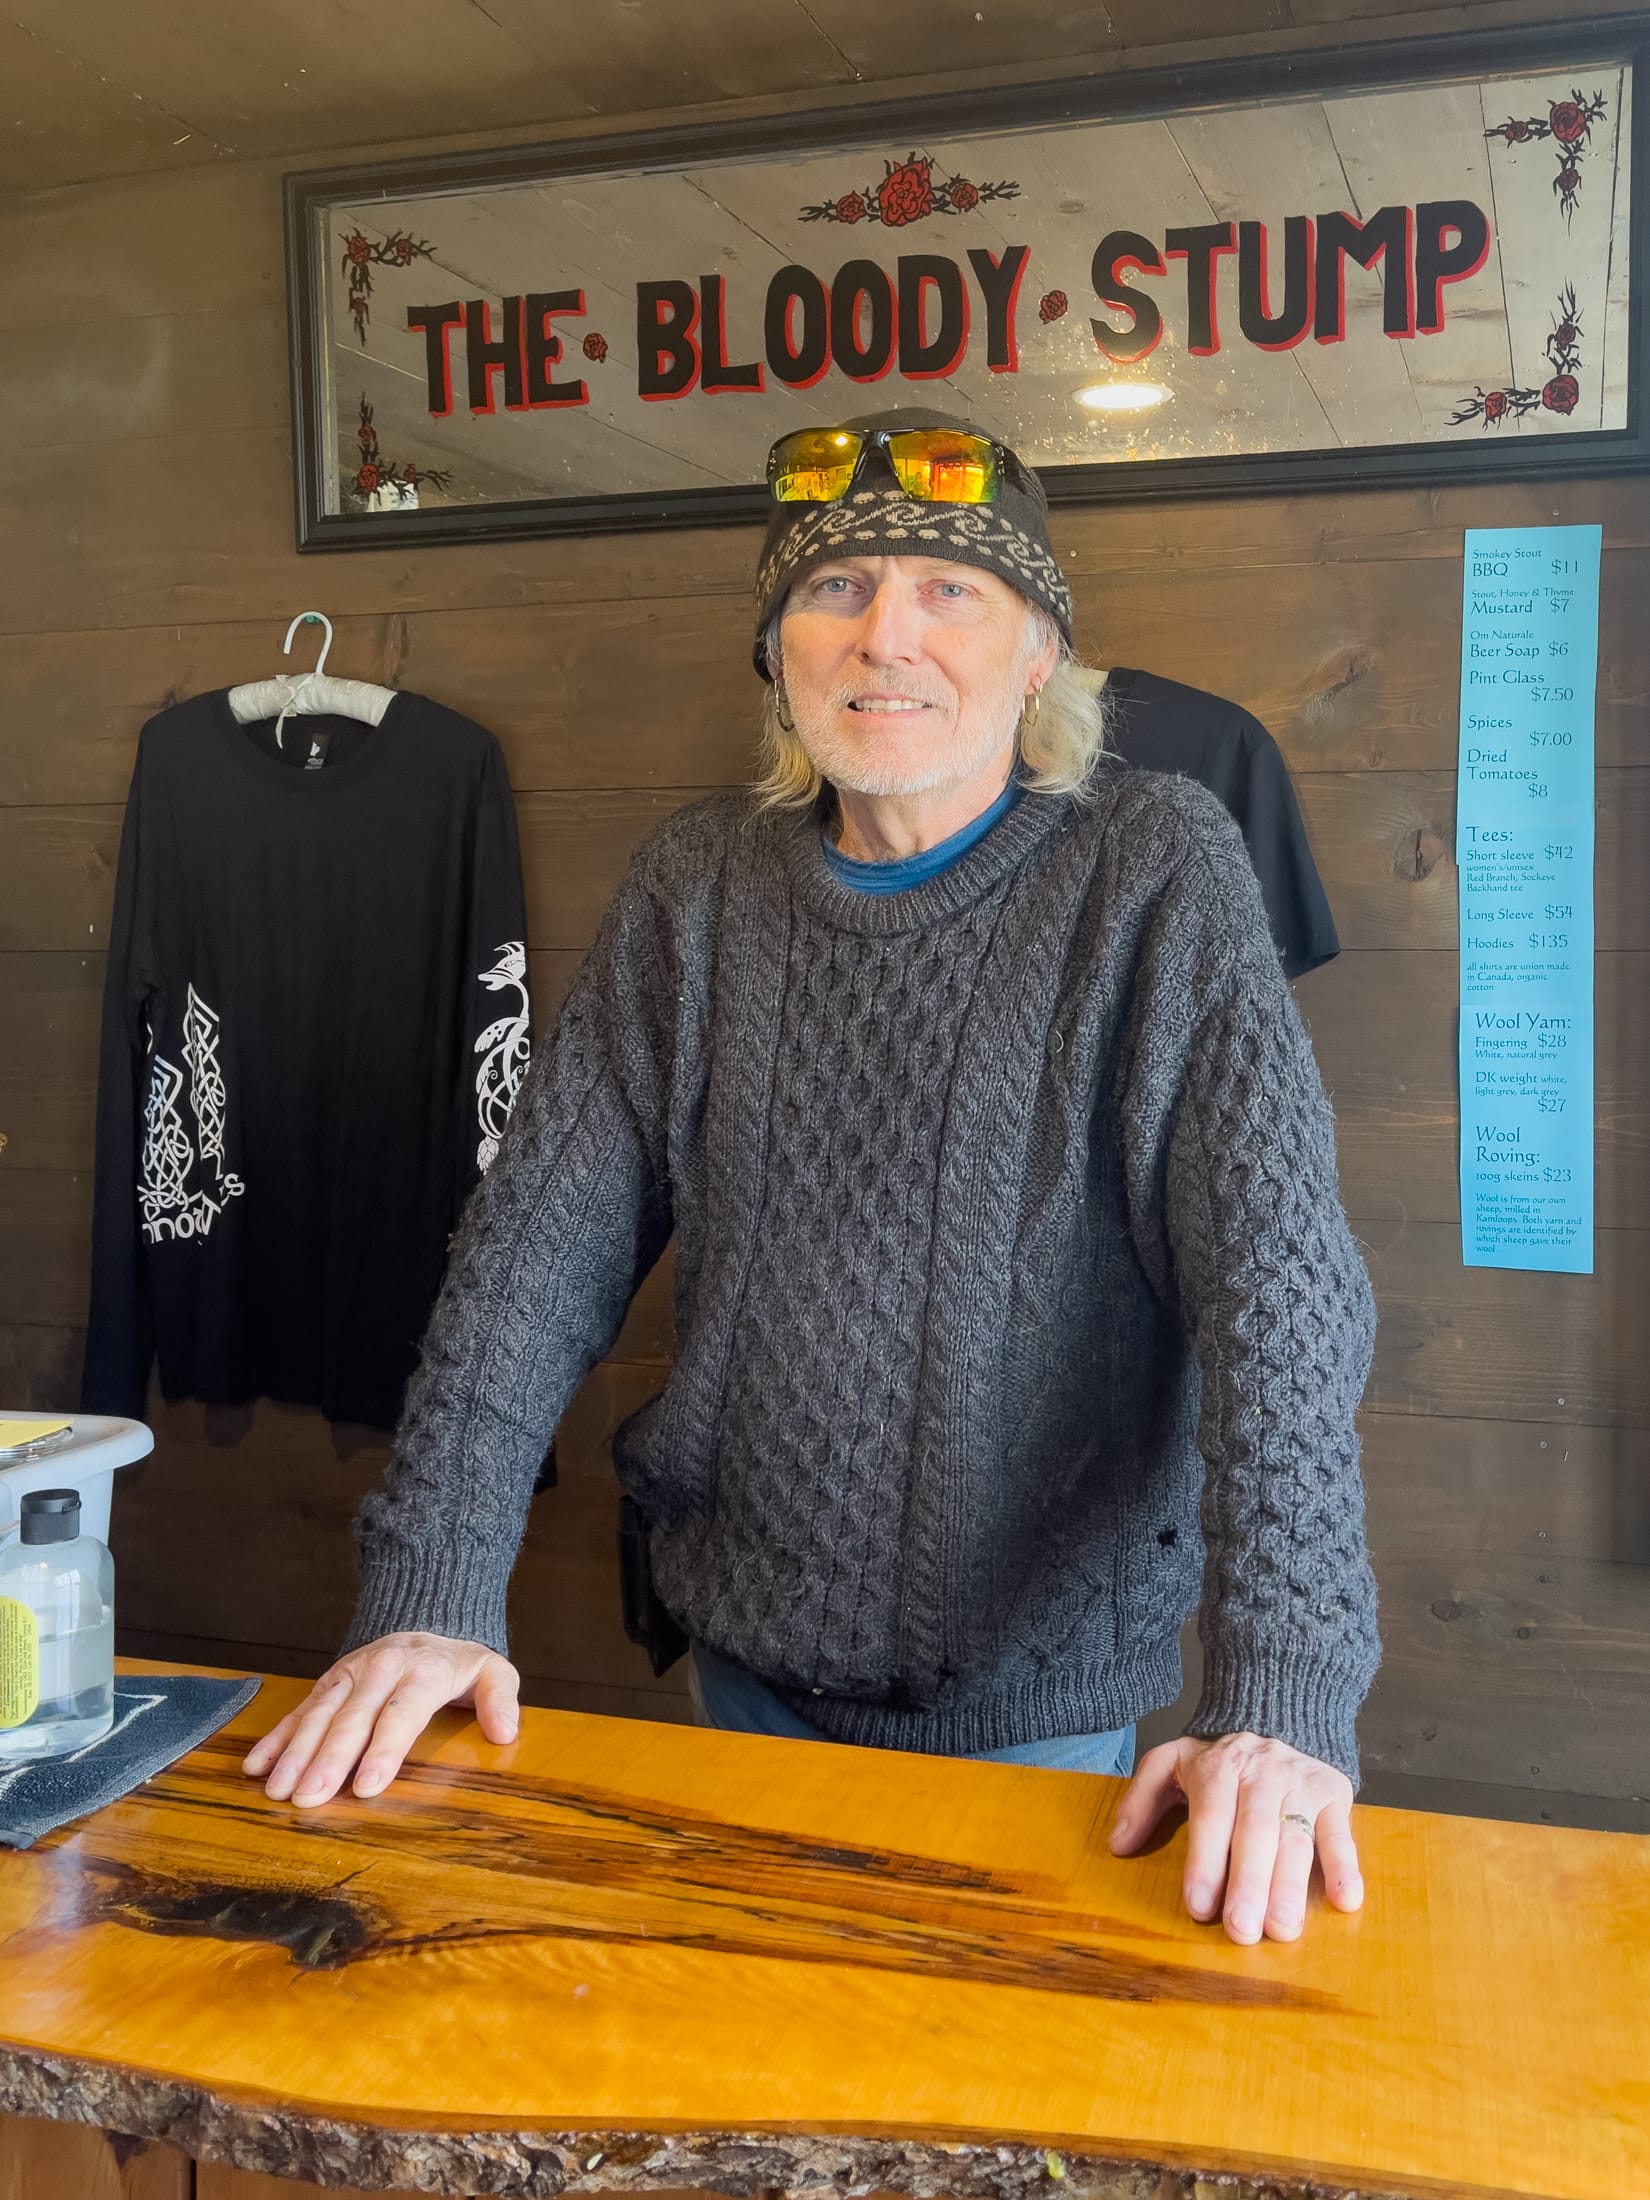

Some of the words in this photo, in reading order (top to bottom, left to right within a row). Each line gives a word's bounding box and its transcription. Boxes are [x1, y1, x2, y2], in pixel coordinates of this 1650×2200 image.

[407, 288, 590, 418] THE
[636, 244, 1031, 402] BLOODY
[1089, 200, 1491, 365] STUMP
[1472, 549, 1512, 560] Smokey
[1514, 548, 1542, 558] Stout
[1473, 562, 1508, 577] BBQ
[1552, 559, 1578, 575] $11
[1472, 590, 1497, 599] Stout,
[1500, 590, 1530, 598] Honey
[1543, 588, 1574, 597] Thyme
[1471, 600, 1533, 615] Mustard
[1550, 598, 1570, 613] $7
[1470, 631, 1489, 640] Om
[1492, 630, 1534, 639] Naturale
[1470, 644, 1501, 658] Beer
[1505, 643, 1540, 659] Soap
[1549, 641, 1568, 656] $6
[1470, 671, 1497, 684] Pint
[1503, 670, 1544, 684] Glass
[1531, 687, 1574, 701] $7.50
[1467, 715, 1512, 731] Spices
[1530, 731, 1572, 747] $7.00
[1467, 749, 1507, 762] Dried
[1466, 767, 1538, 780] Tomatoes
[1529, 783, 1548, 798] $8
[1466, 826, 1513, 842] Tees:
[1466, 850, 1496, 860] Short
[1501, 851, 1534, 860] sleeve
[1544, 845, 1573, 860] $42
[1466, 874, 1484, 882] Red
[1486, 873, 1518, 882] Branch,
[1467, 884, 1508, 892] Backhand
[1467, 909, 1494, 922] Long
[1498, 909, 1534, 920] Sleeve
[1545, 904, 1573, 920] $54
[1467, 938, 1514, 949] Hoodies
[1529, 933, 1568, 949] $135
[1467, 962, 1477, 971] all
[1479, 962, 1502, 971] shirts
[1520, 962, 1544, 970] union
[1547, 962, 1570, 970] made
[1477, 973, 1514, 981] Canada,
[1476, 1013, 1520, 1029] Wool
[1526, 1012, 1572, 1032] Yarn:
[1475, 1037, 1527, 1049] Fingering
[1537, 1033, 1567, 1048] $28
[1475, 1050, 1504, 1059] White,
[1507, 1051, 1537, 1059] natural
[1539, 1052, 1557, 1060] grey
[1476, 1072, 1497, 1083] DK
[1500, 1073, 1537, 1085] weight
[1541, 1076, 1567, 1084] white,
[1475, 1087, 1494, 1096] light
[1520, 1087, 1538, 1095] dark
[1541, 1089, 1560, 1097] grey
[1537, 1096, 1566, 1113] $27
[1477, 1126, 1520, 1142] Wool
[1477, 1146, 1540, 1166] Roving:
[1477, 1173, 1500, 1183] 100g
[1504, 1171, 1539, 1182] skeins
[1543, 1167, 1572, 1183] $23
[1476, 1193, 1498, 1202] Wool
[1510, 1195, 1530, 1204] from
[1476, 1205, 1502, 1214] sheep,
[1505, 1206, 1530, 1214] milled
[1522, 1216, 1542, 1224] Both
[1545, 1217, 1564, 1225] yarn
[1566, 1217, 1582, 1225] and
[1476, 1225, 1506, 1234] rovings
[1524, 1226, 1563, 1236] identified
[1566, 1227, 1576, 1235] by
[1476, 1235, 1500, 1243] which
[1504, 1236, 1527, 1245] sheep
[1530, 1237, 1549, 1245] gave
[1552, 1237, 1572, 1245] their
